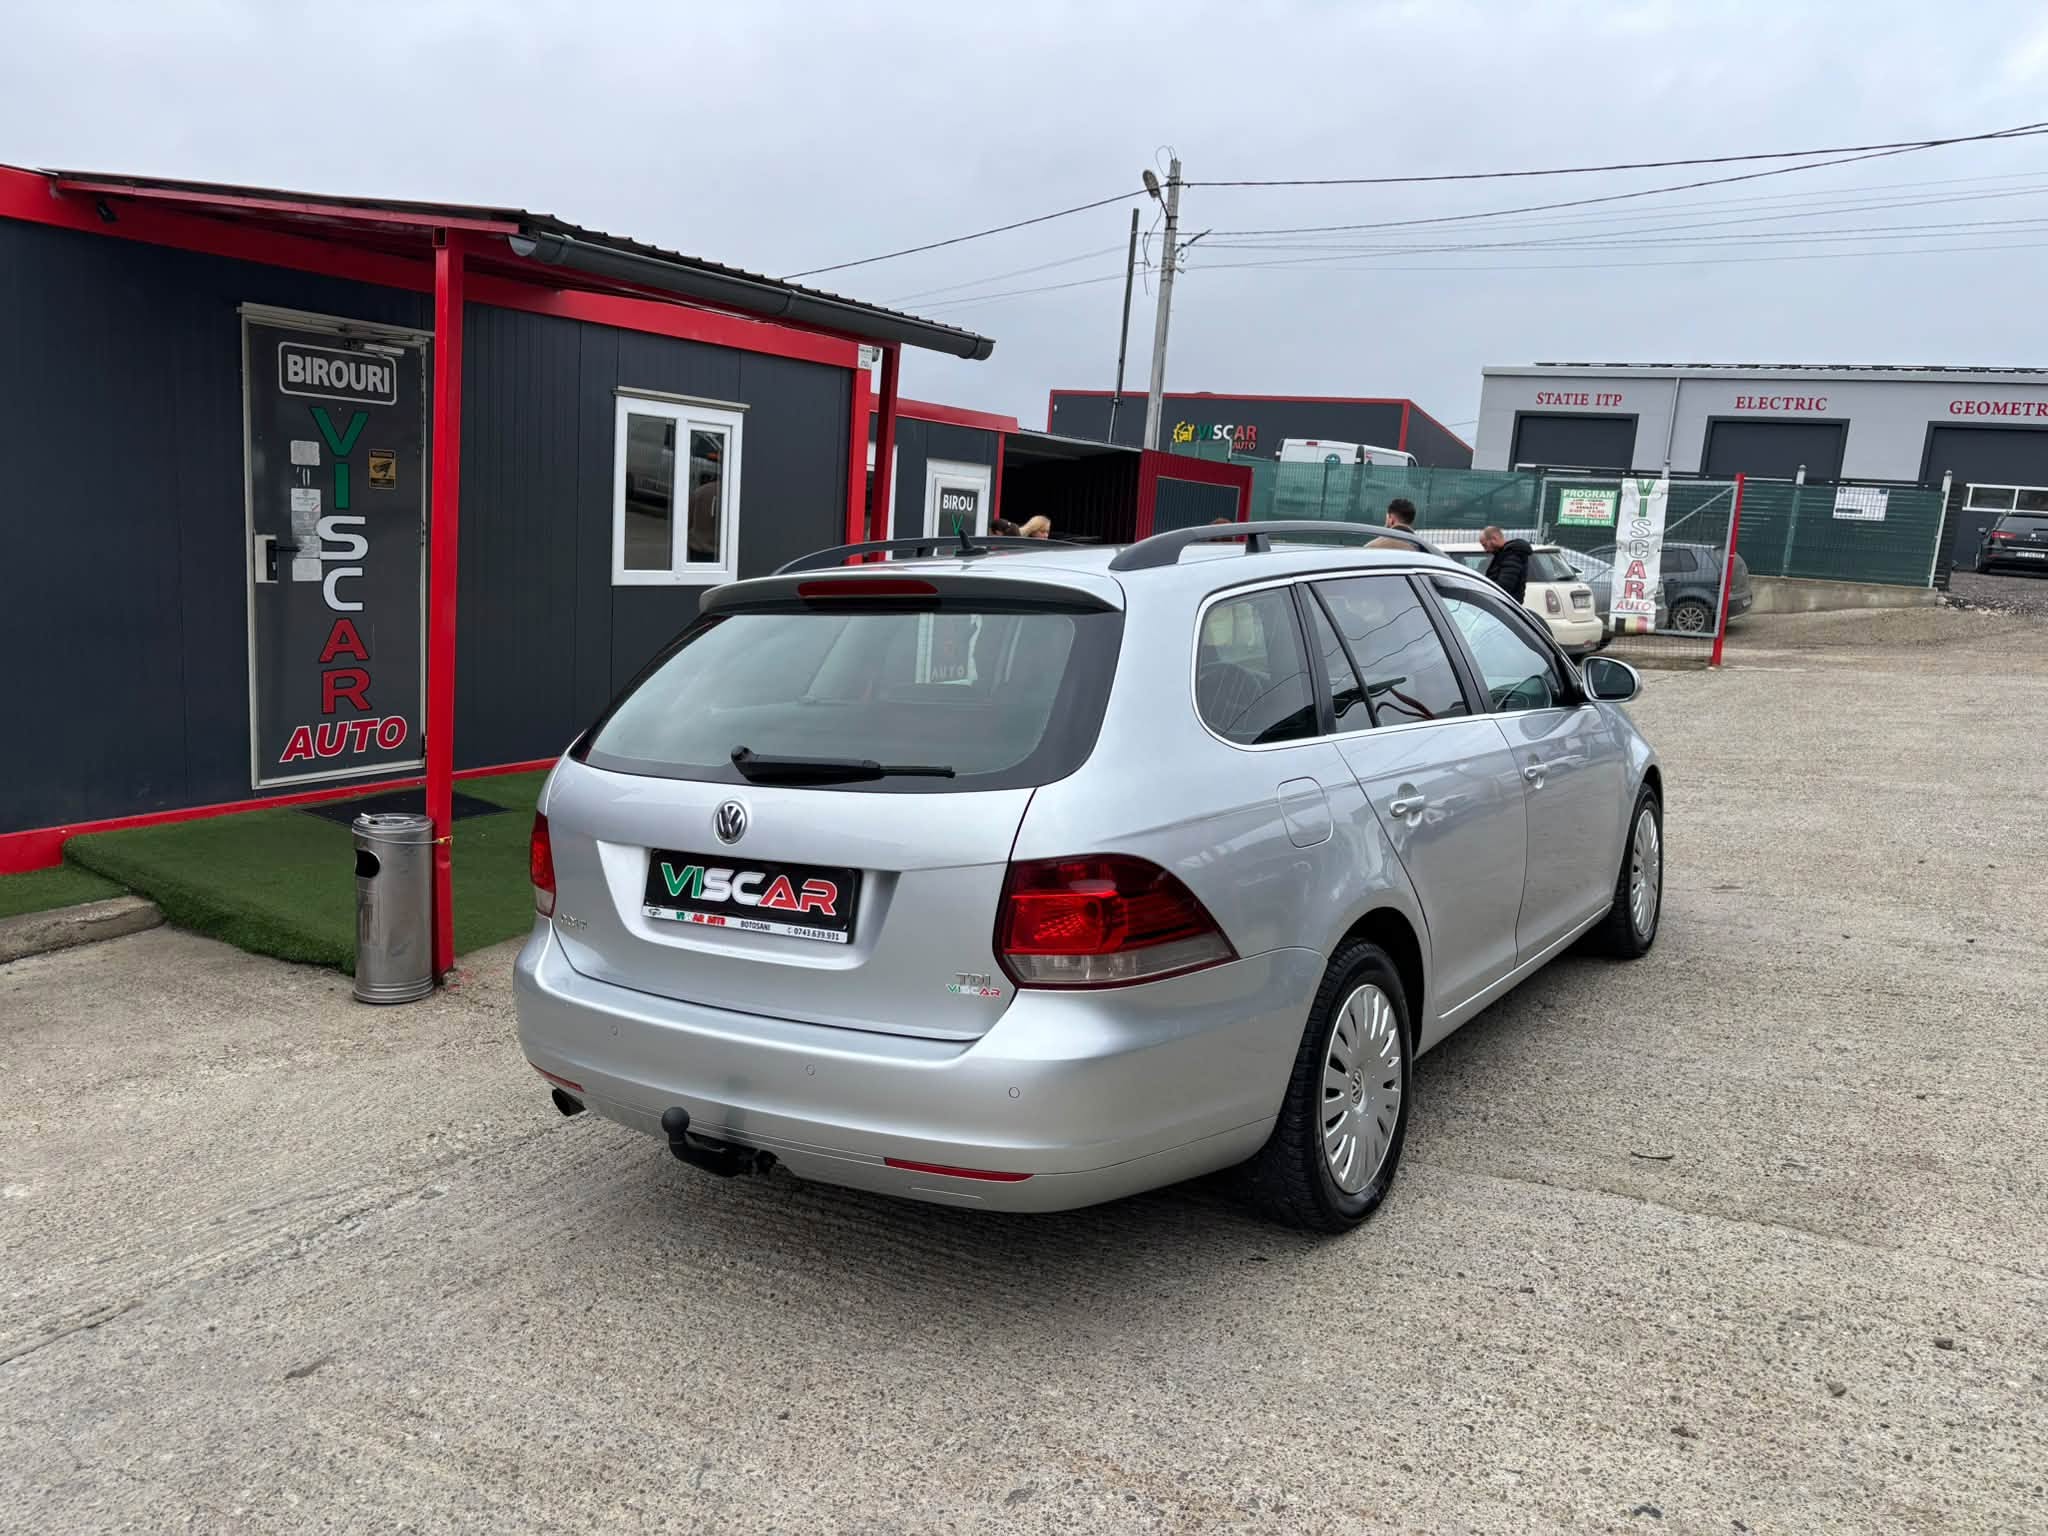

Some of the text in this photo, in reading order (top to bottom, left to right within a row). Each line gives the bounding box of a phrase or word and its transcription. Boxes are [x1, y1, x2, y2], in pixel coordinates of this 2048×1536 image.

[287, 354, 391, 394] BIROURI
[1535, 391, 1623, 407] STATIE ITP
[1734, 396, 1828, 411] ELECTRIC
[1949, 400, 2048, 417] GEOMETR
[1197, 424, 1257, 441] VISCAR
[1232, 441, 1257, 450] AUTO
[942, 494, 974, 511] BIROU
[1563, 489, 1616, 499] PROGRAM
[1624, 479, 1656, 600] VISCAR
[310, 406, 373, 715] VISCAR
[1615, 600, 1651, 611] AUTO
[279, 715, 408, 763] AUTO
[660, 862, 838, 917] VISCAR
[954, 972, 991, 986] TDI
